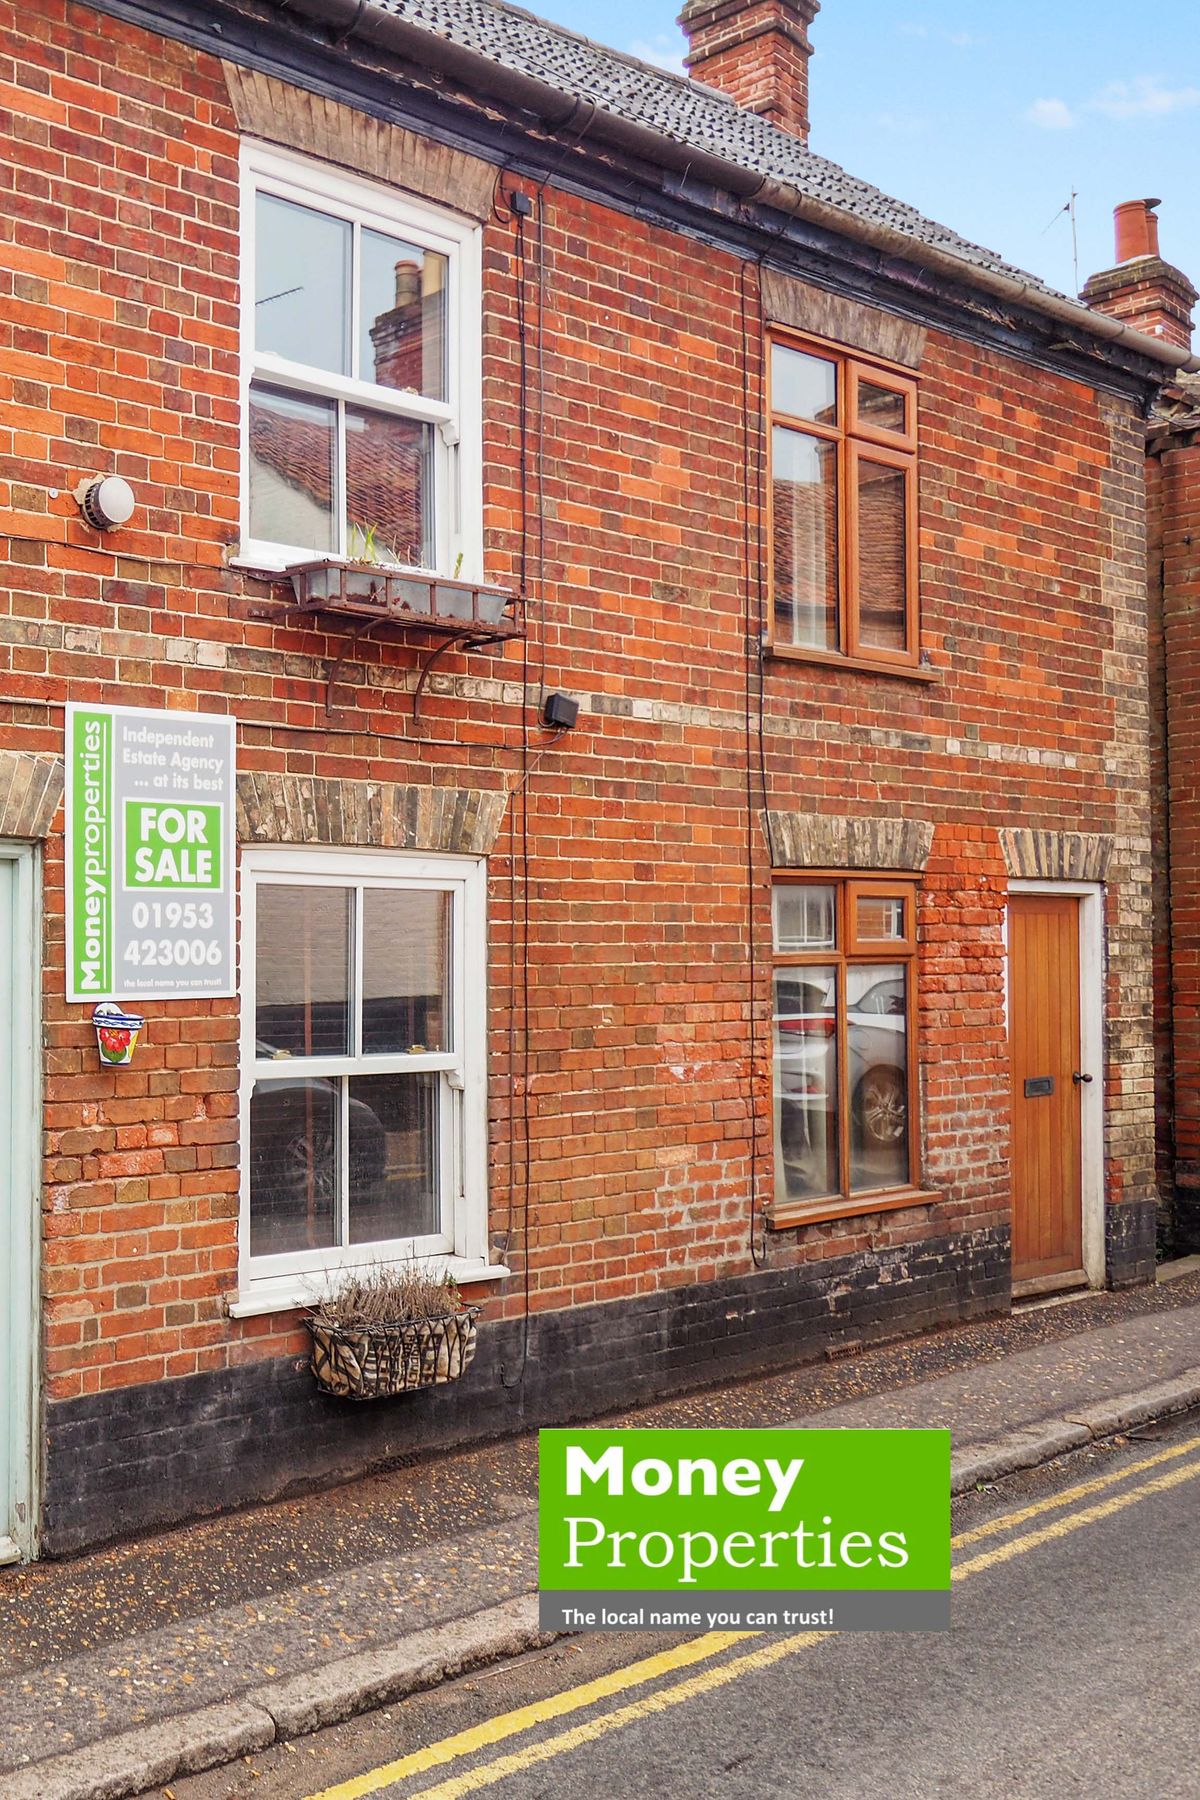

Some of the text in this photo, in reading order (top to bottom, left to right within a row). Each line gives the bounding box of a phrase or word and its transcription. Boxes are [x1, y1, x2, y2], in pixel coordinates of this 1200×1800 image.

[123, 726, 214, 748] Independent
[123, 748, 224, 774] Estate Agency
[153, 774, 168, 787] at
[173, 772, 189, 788] its
[193, 773, 224, 790] best
[140, 807, 208, 844] FOR
[135, 847, 212, 883] SALE
[132, 902, 214, 929] 01953
[124, 939, 222, 966] 423006
